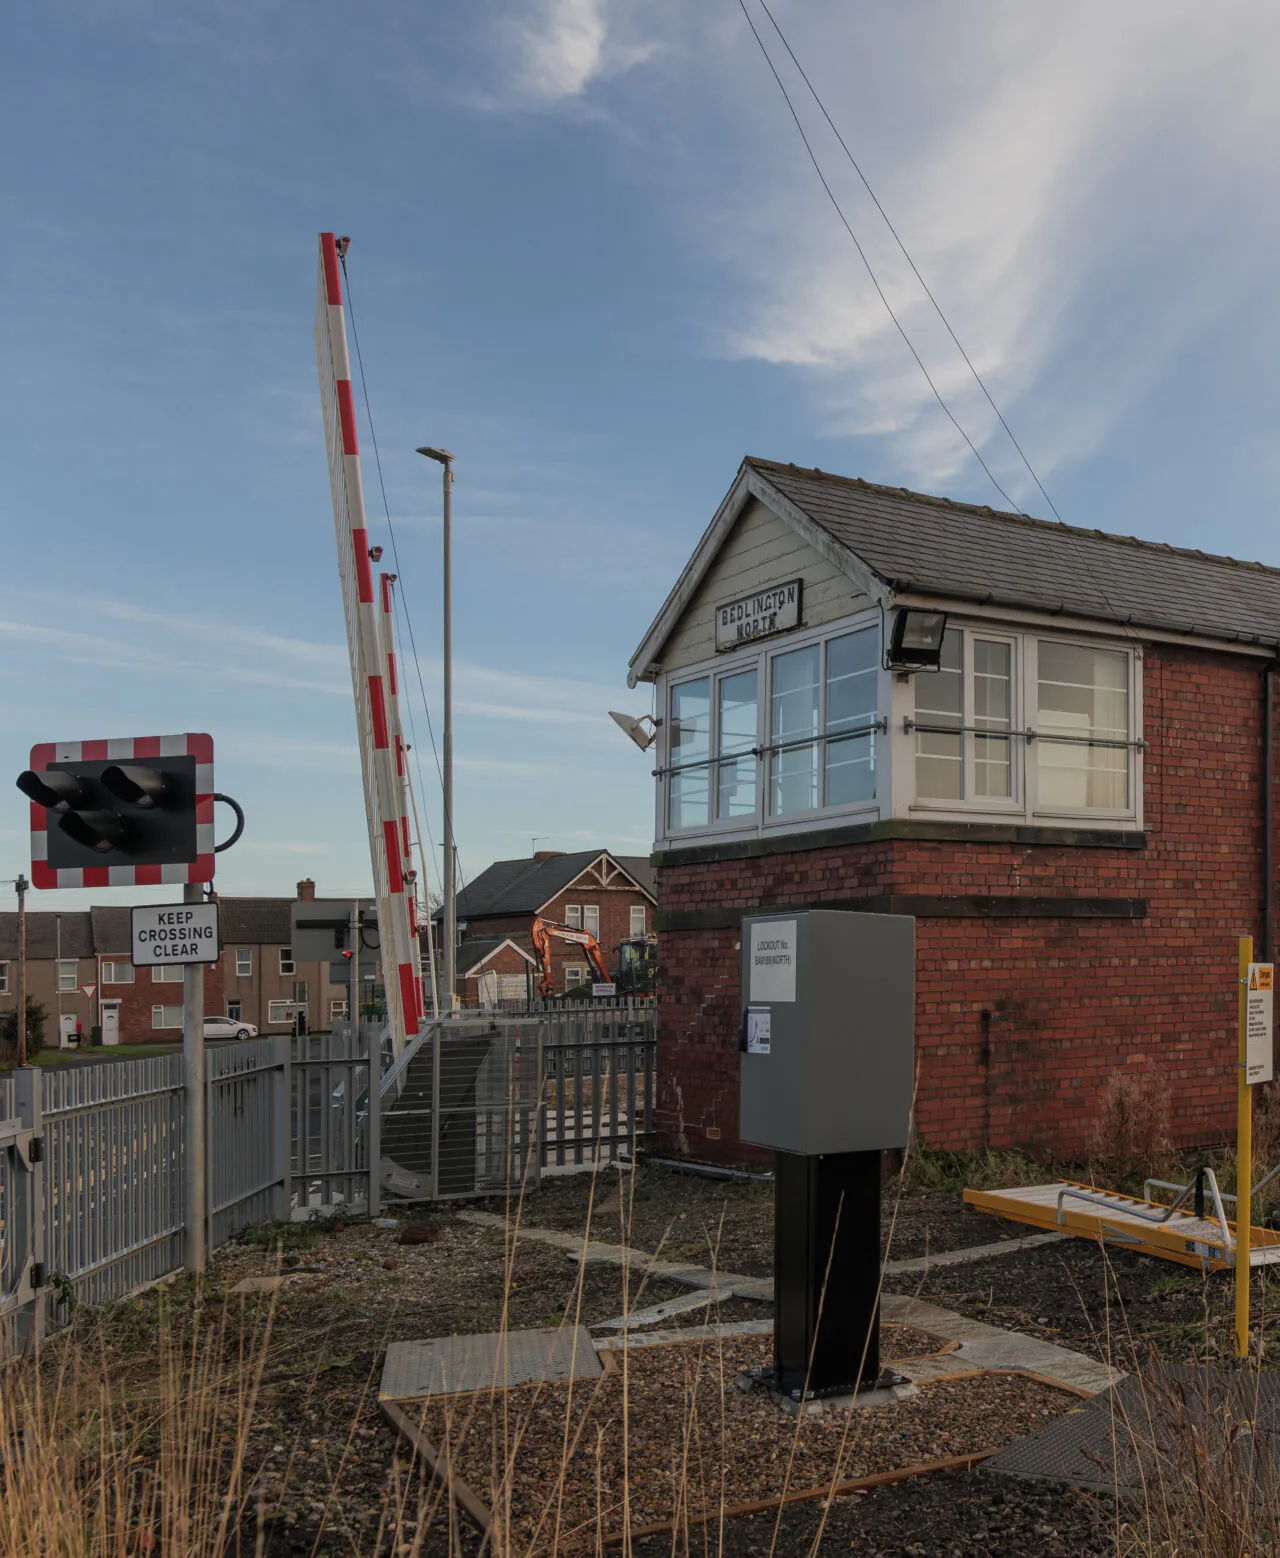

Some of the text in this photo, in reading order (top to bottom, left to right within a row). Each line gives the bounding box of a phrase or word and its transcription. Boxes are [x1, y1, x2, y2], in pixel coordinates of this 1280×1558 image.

[722, 586, 795, 626] BEDLINGTON
[736, 613, 778, 641] NORTH
[158, 911, 194, 925] KEEP
[138, 926, 213, 942] CROSSING
[153, 943, 199, 957] CLEAR
